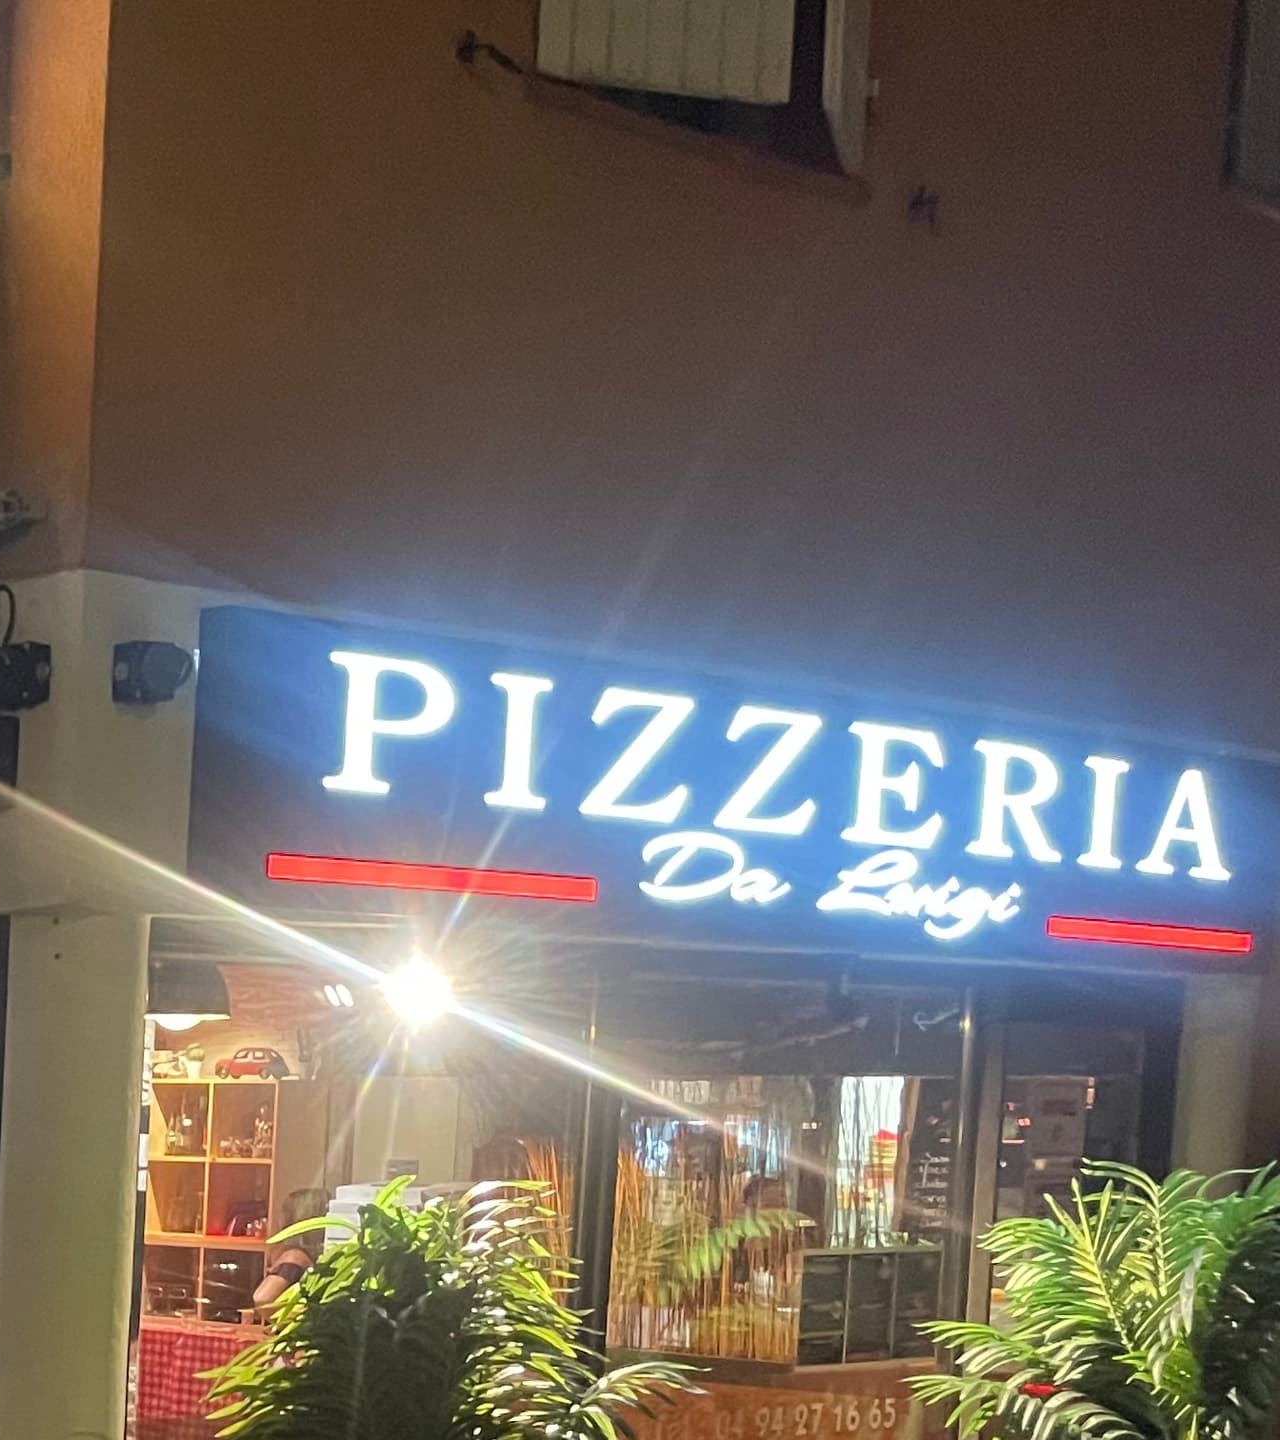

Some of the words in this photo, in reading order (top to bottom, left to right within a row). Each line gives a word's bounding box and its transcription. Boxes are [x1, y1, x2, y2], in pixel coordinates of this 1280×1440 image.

[321, 649, 1232, 881] PIZZERIA
[638, 830, 792, 904] Da
[815, 849, 1022, 940] Luigi
[756, 1406, 785, 1438] 94
[794, 1403, 825, 1436] 27
[832, 1400, 861, 1433] 16
[869, 1398, 897, 1429] 65
